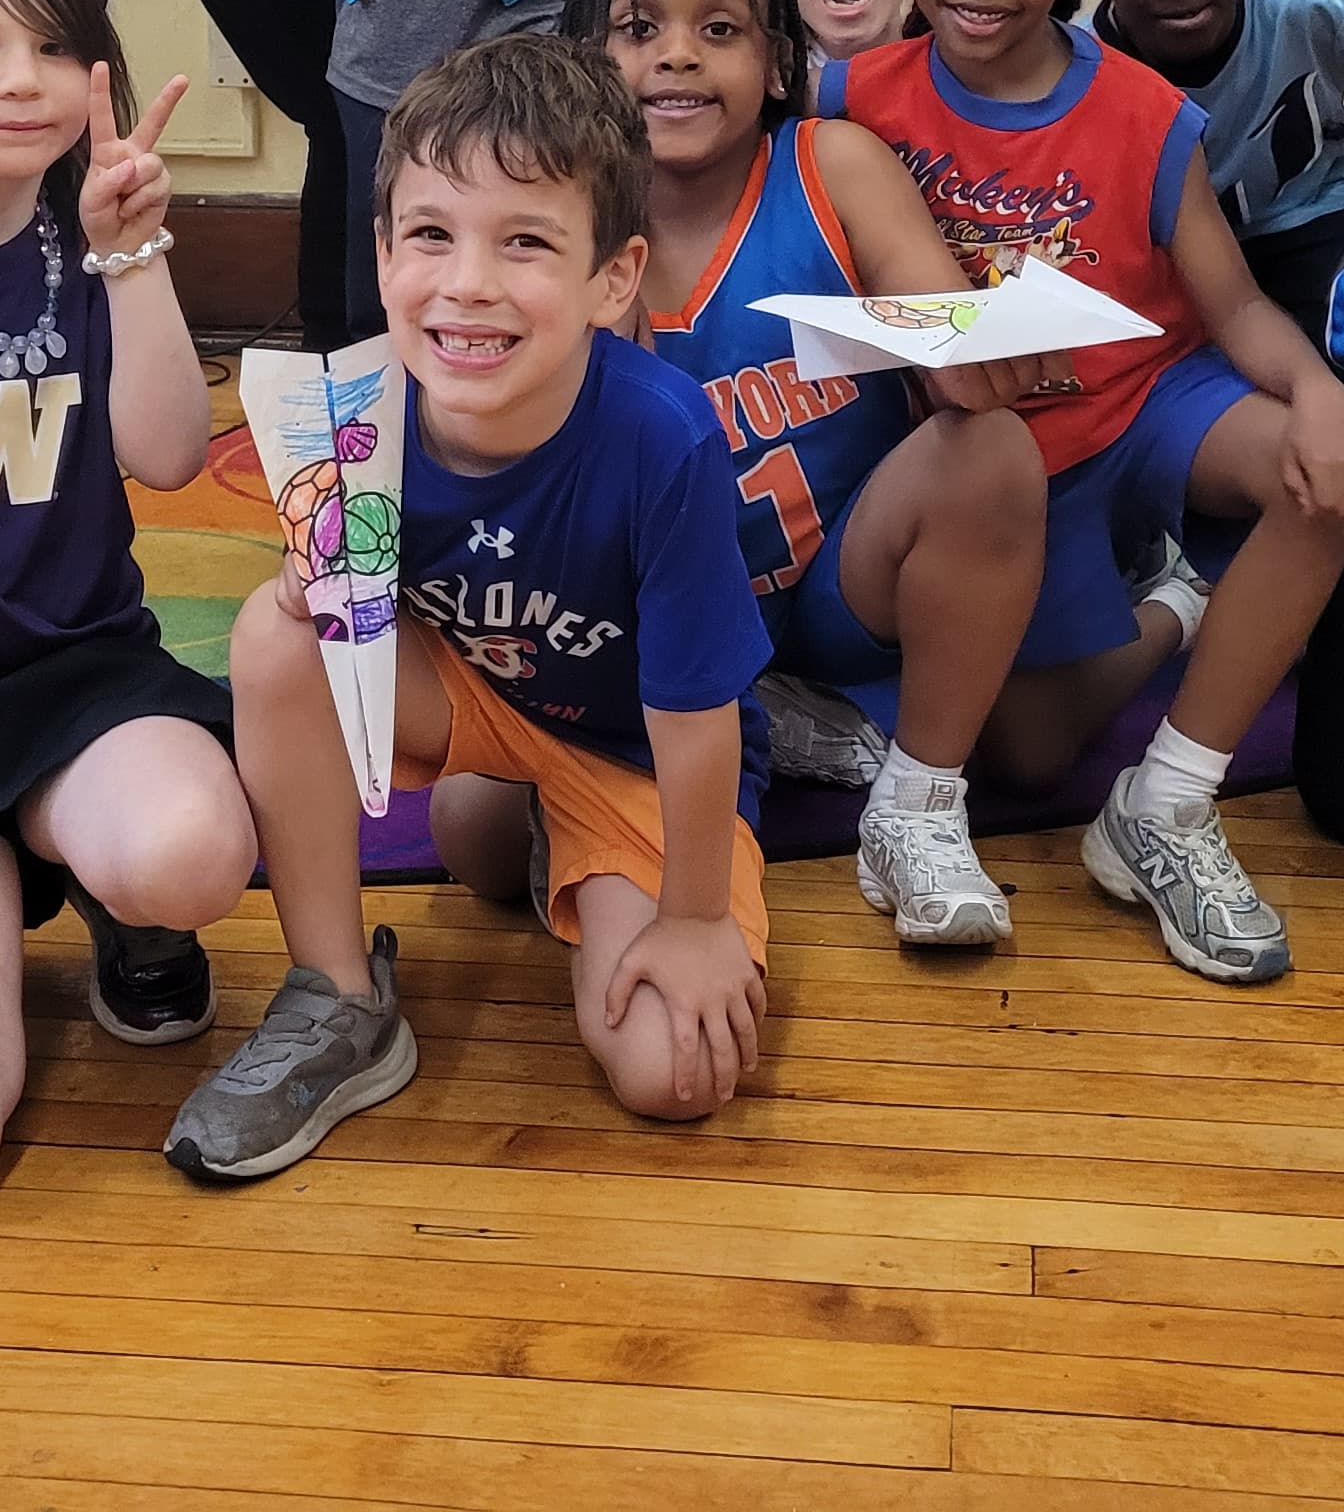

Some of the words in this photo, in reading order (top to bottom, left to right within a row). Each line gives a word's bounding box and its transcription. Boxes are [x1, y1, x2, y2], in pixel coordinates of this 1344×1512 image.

[893, 139, 1095, 223] Mickey's
[948, 219, 988, 242] Star
[996, 225, 1035, 240] Team
